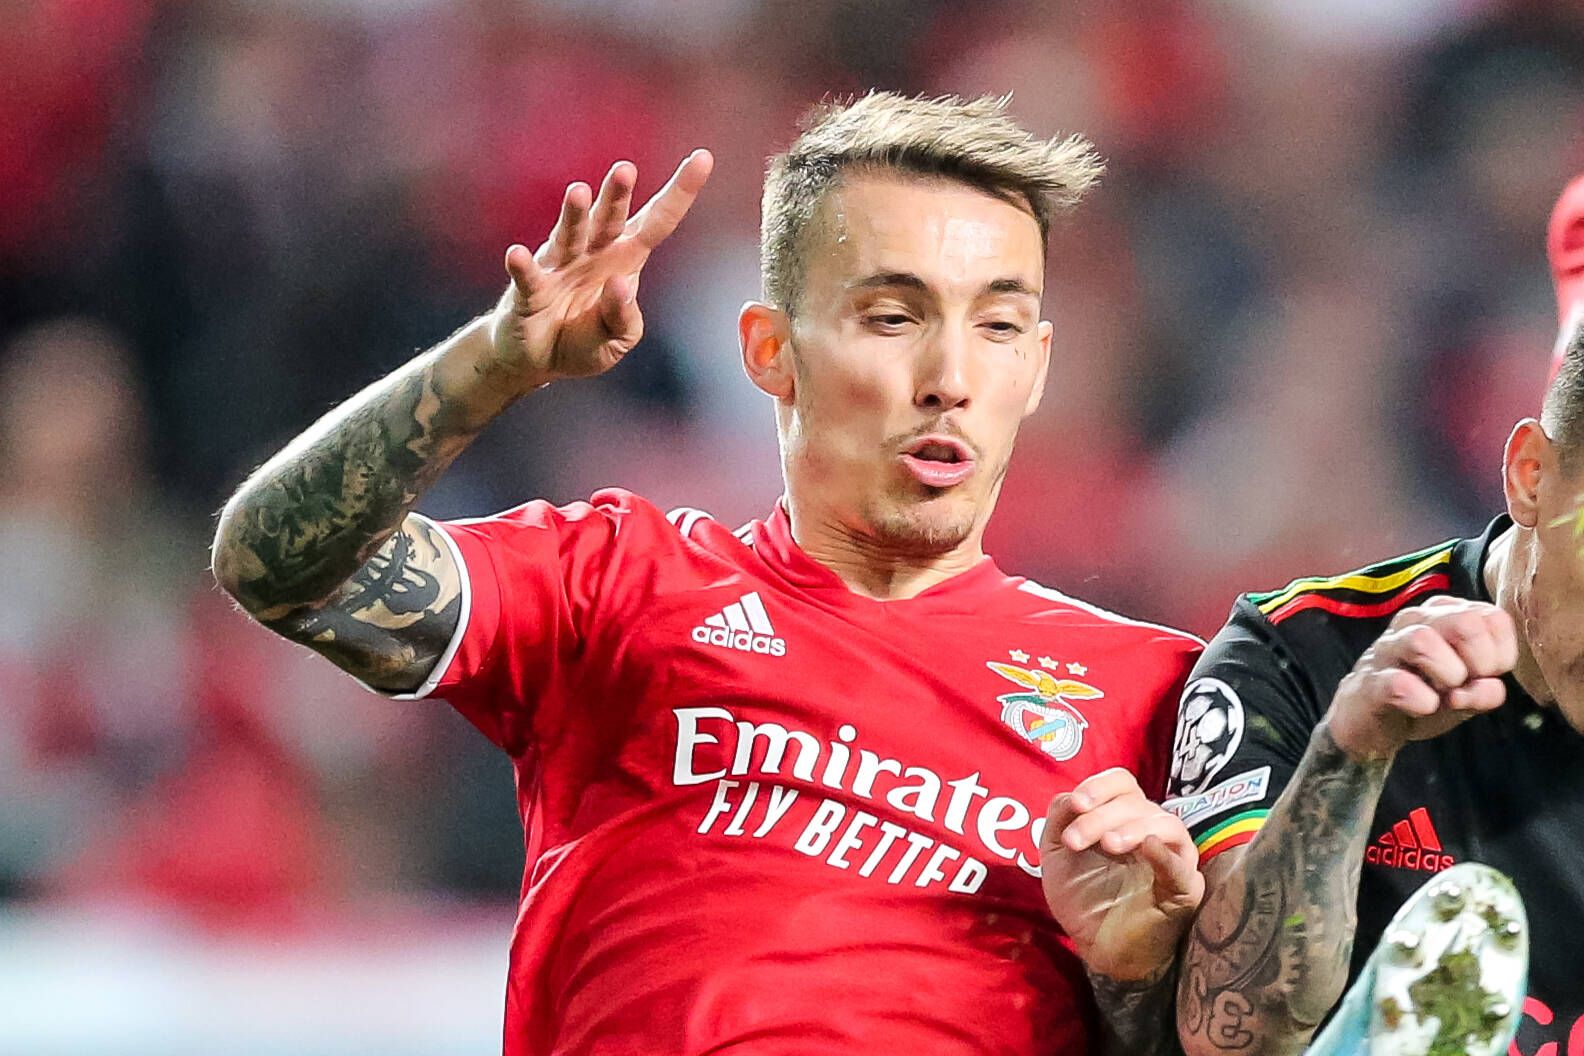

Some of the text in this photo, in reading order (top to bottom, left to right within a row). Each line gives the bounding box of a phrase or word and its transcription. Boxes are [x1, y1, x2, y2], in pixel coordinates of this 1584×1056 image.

[692, 625, 787, 657] adidas
[697, 780, 800, 836] FLY
[1366, 846, 1455, 872] adidas
